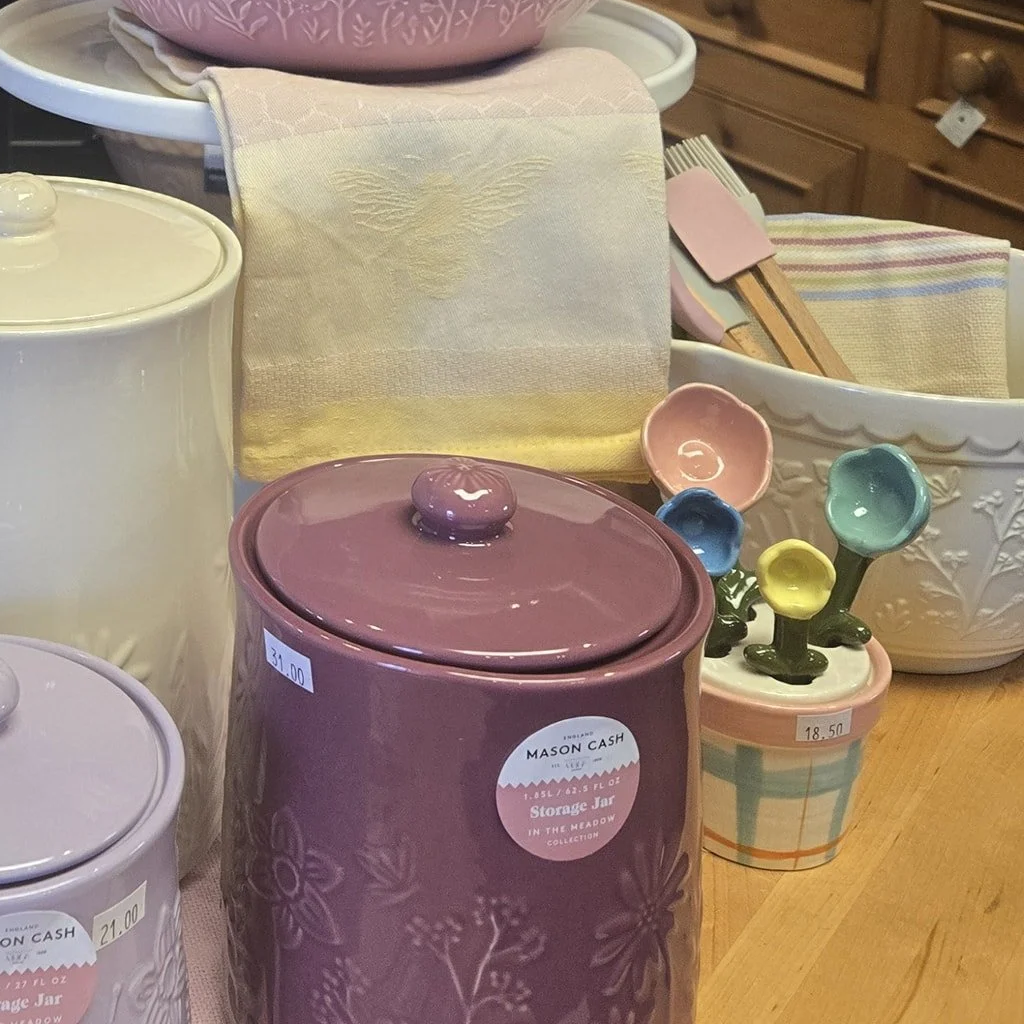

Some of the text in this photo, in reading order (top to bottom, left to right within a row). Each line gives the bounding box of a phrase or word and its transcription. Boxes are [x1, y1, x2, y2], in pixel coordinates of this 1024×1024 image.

[271, 646, 305, 686] 31.00
[805, 722, 843, 741] 18.50
[526, 732, 625, 760] MASON CASH
[565, 785, 589, 796] 62.5
[593, 782, 605, 791] FL
[608, 776, 621, 787] OZ
[530, 794, 616, 819] Storage Jar
[528, 814, 616, 837] IN THE MEADOW
[546, 831, 600, 847] COLLECTION
[100, 903, 139, 946] 21.00
[31, 927, 76, 943] CASH
[15, 979, 27, 990] 27
[33, 978, 45, 986] FL
[51, 975, 67, 985] OZ
[34, 992, 63, 1008] Jar
